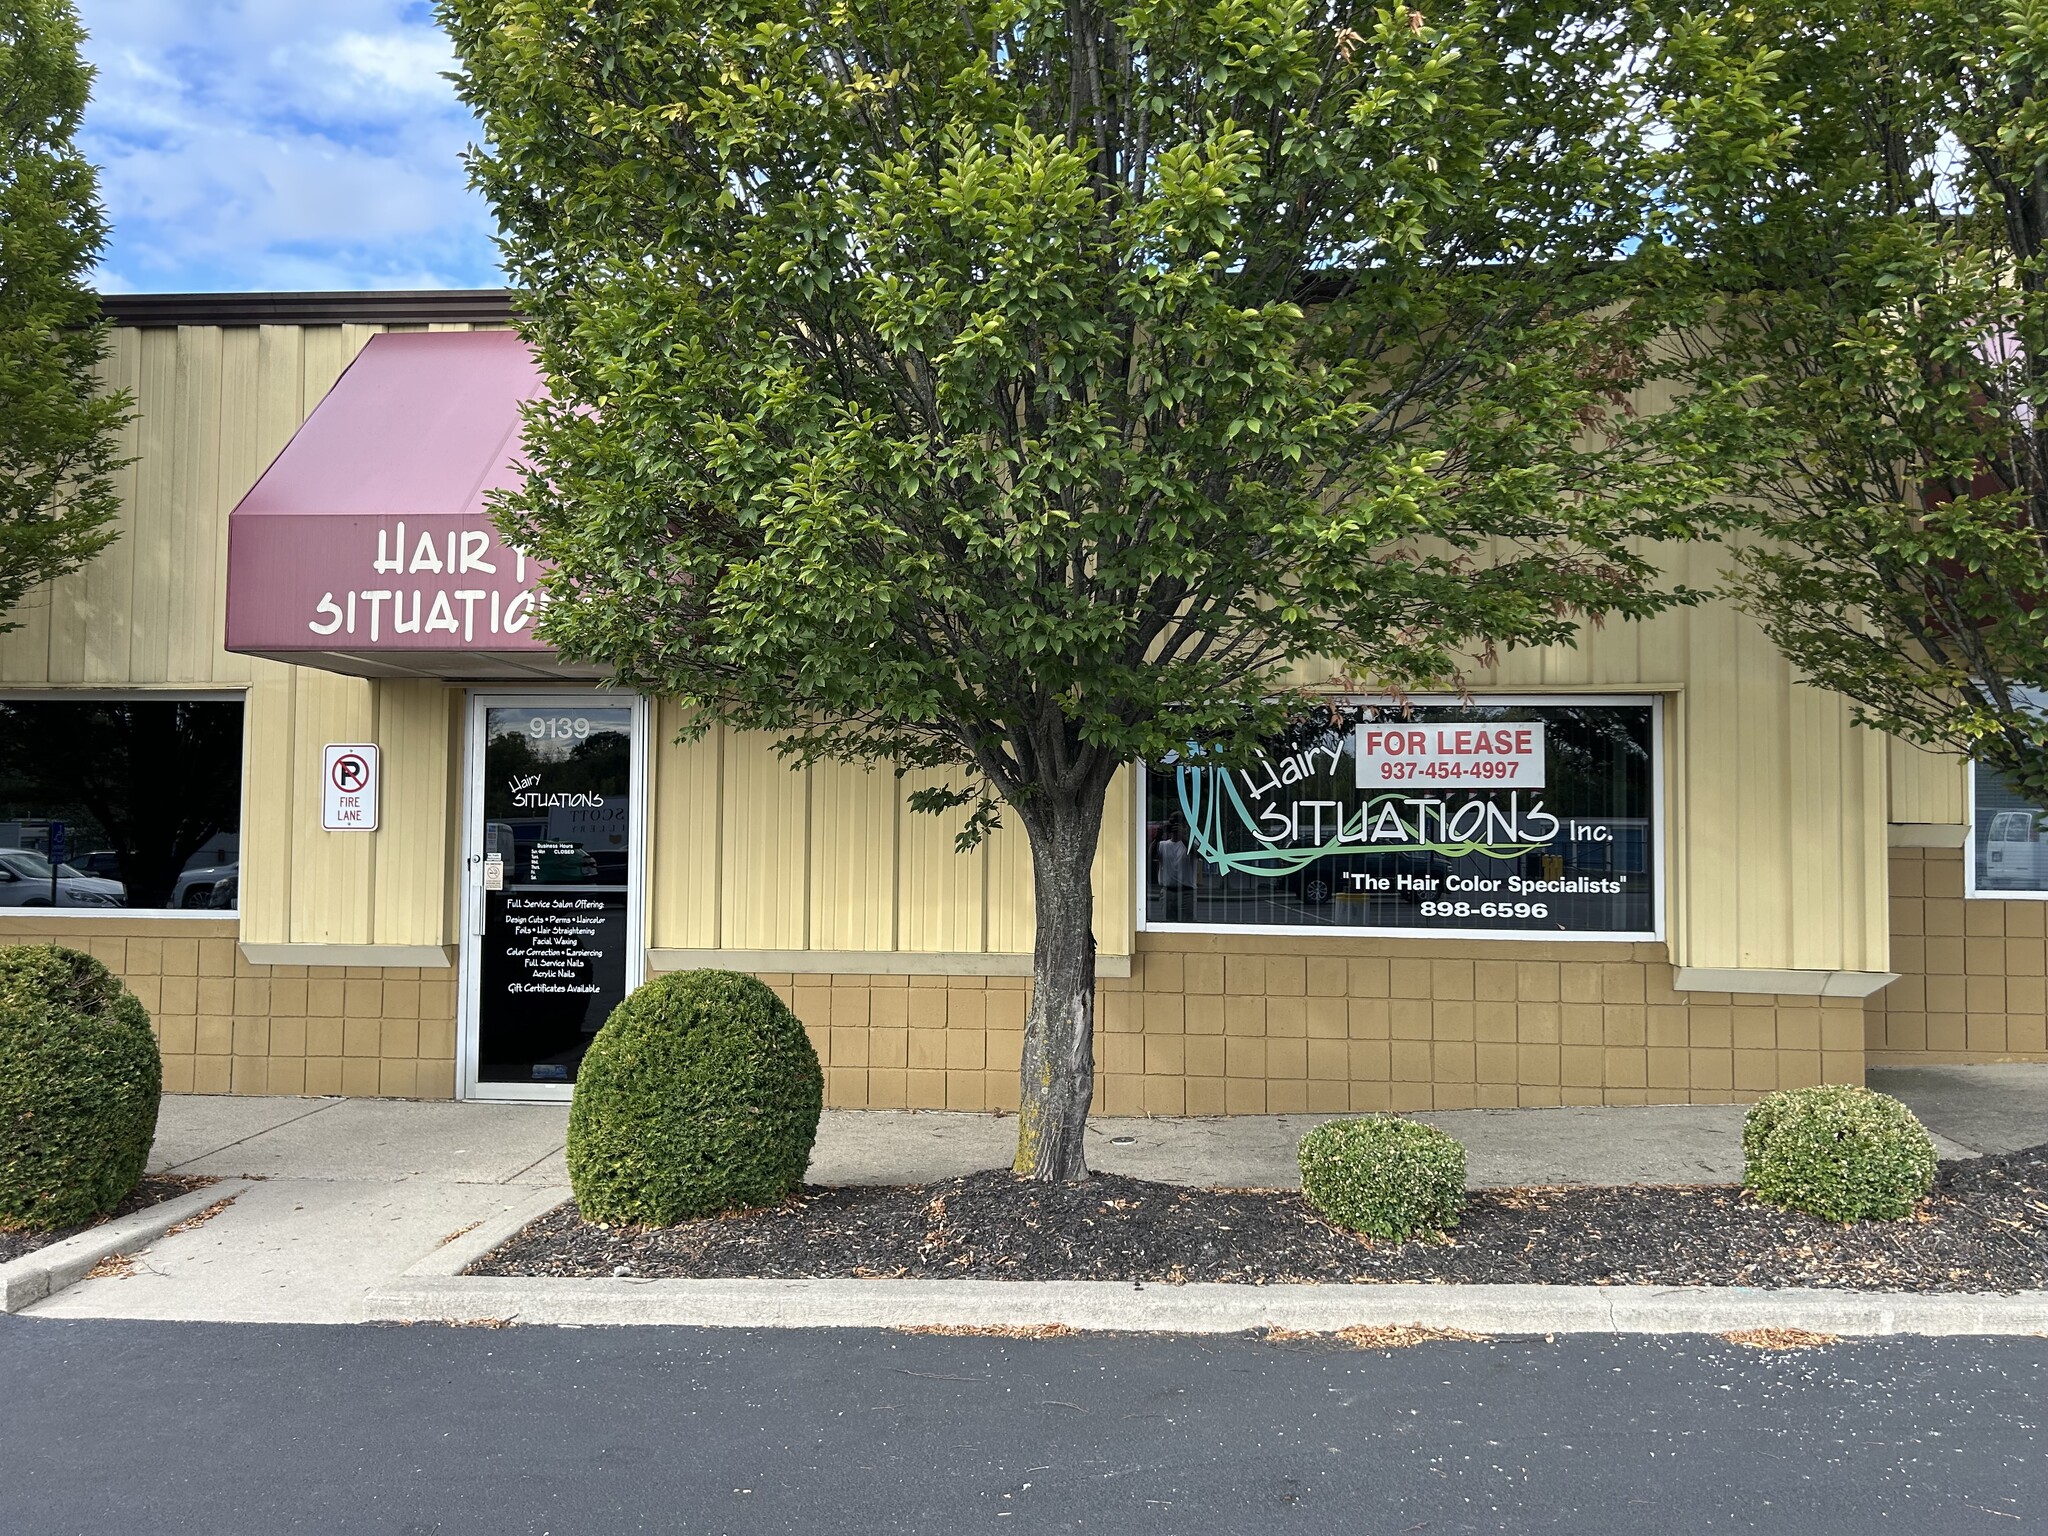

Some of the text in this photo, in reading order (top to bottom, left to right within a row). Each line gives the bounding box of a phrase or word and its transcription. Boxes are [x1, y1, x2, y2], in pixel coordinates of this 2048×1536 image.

[529, 717, 590, 739] 9139
[1367, 730, 1532, 756] FOR LEASE
[1239, 740, 1345, 801] Hairy
[1380, 761, 1519, 780] 937-454-4997
[508, 773, 542, 794] Hairy
[339, 796, 361, 808] FIRE
[512, 790, 604, 809] SITUATIONS
[337, 810, 362, 821] LANE
[1252, 790, 1614, 847] SITUATIONS Inc.
[1342, 871, 1628, 896] "The Hair Color Specialists"
[507, 898, 522, 909] Full
[523, 899, 551, 909] Service
[551, 899, 574, 909] Salon
[1420, 901, 1549, 919] 898-6596
[505, 914, 606, 925] Design Cuts Perms Haircolor
[515, 925, 596, 936] Foils Hair Straightening
[532, 936, 578, 947] Facial Waxing
[506, 947, 603, 958] Color Correction Earpiercing
[524, 958, 585, 968] Full Service Nails
[532, 968, 576, 978] Acrylic Nails
[507, 982, 601, 994] Gift Certificates Available
